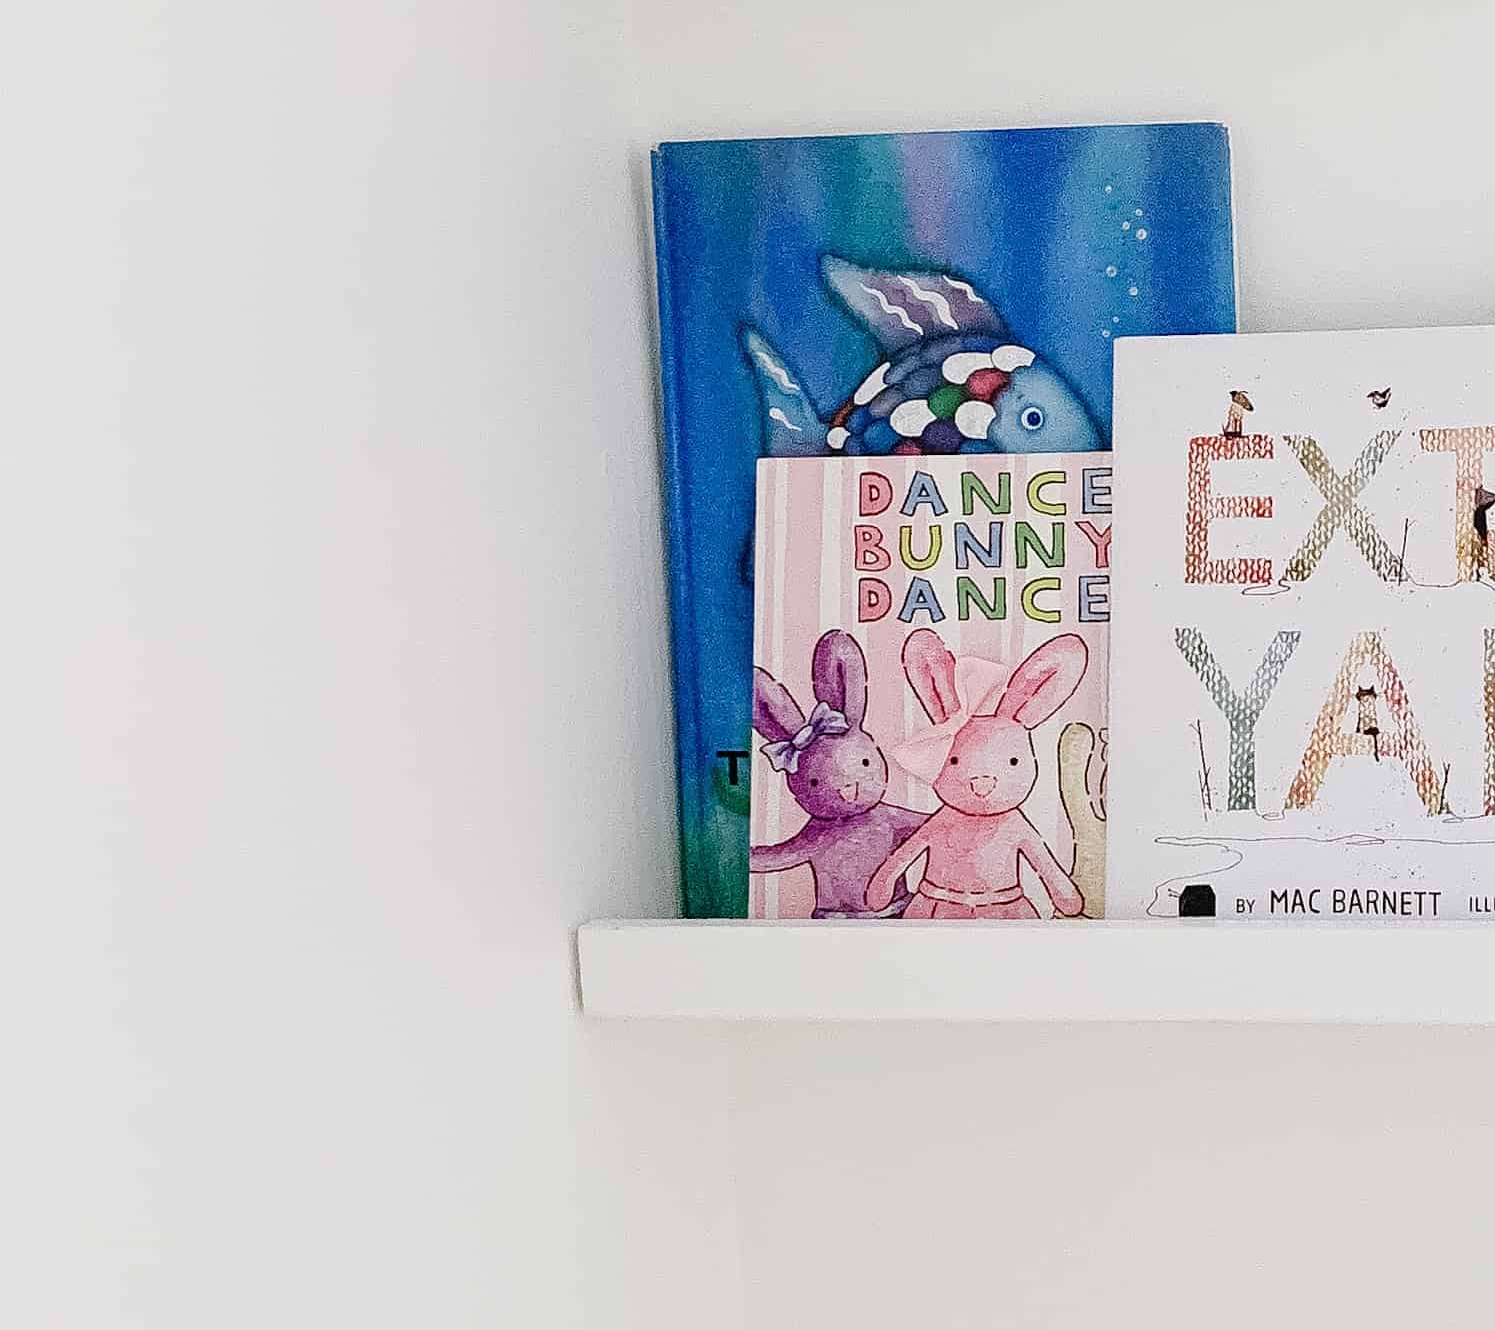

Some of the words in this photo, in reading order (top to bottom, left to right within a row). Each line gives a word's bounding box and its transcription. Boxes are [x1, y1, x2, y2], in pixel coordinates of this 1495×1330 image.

[859, 467, 1112, 516] DANCE
[854, 520, 1112, 572] BUNNY
[858, 575, 1111, 623] DANCE
[1235, 898, 1256, 914] BY
[1270, 888, 1321, 915] MAC
[1332, 889, 1442, 916] BARNETT
